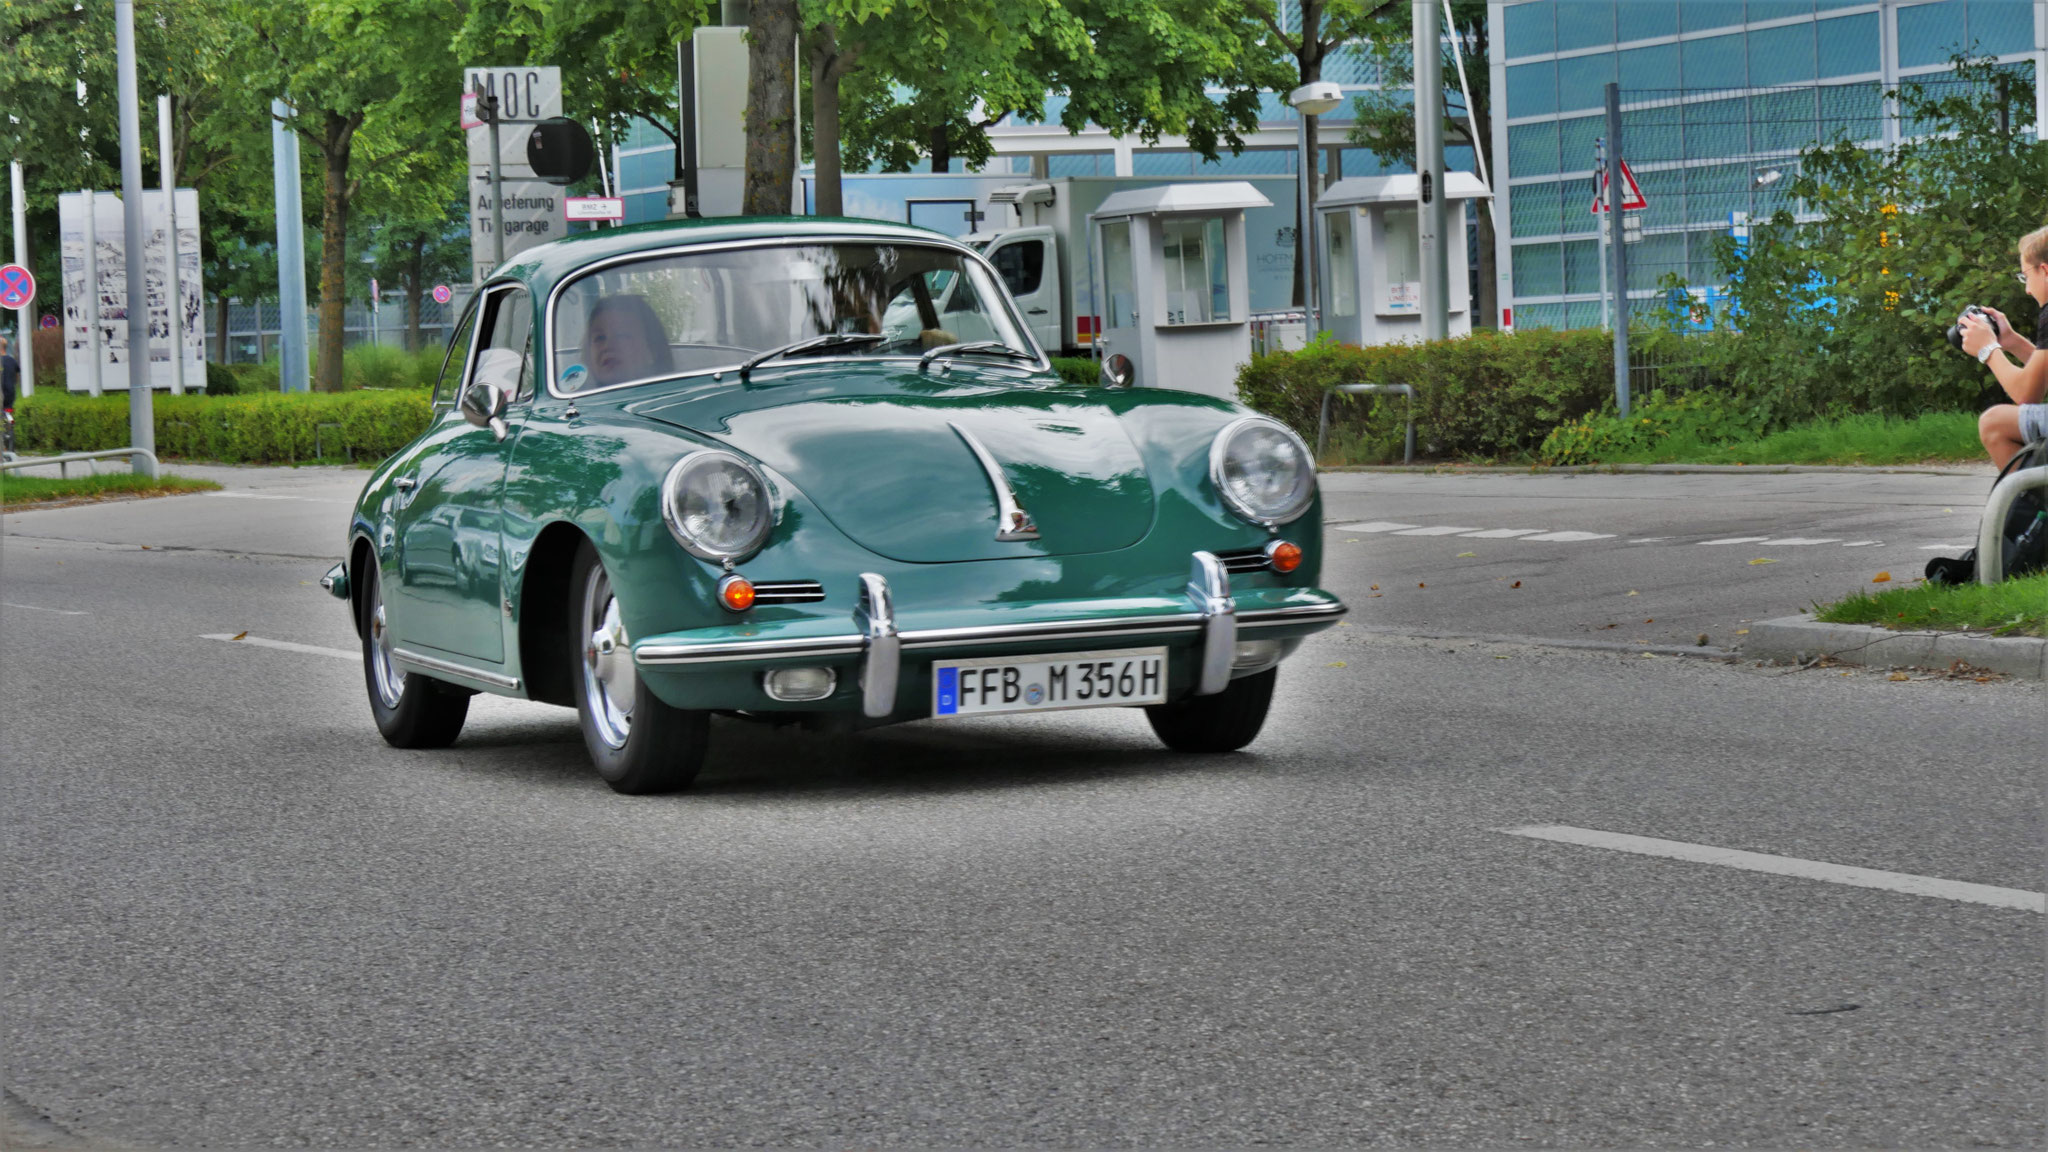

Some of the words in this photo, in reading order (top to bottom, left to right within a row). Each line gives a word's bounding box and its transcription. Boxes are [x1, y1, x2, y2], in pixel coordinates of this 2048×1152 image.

[472, 71, 540, 119] MOC
[477, 192, 555, 212] Aeferung
[478, 217, 550, 236] Tigarage
[960, 666, 1021, 706] FFB
[1049, 664, 1068, 701] M
[1076, 659, 1160, 700] 356H
